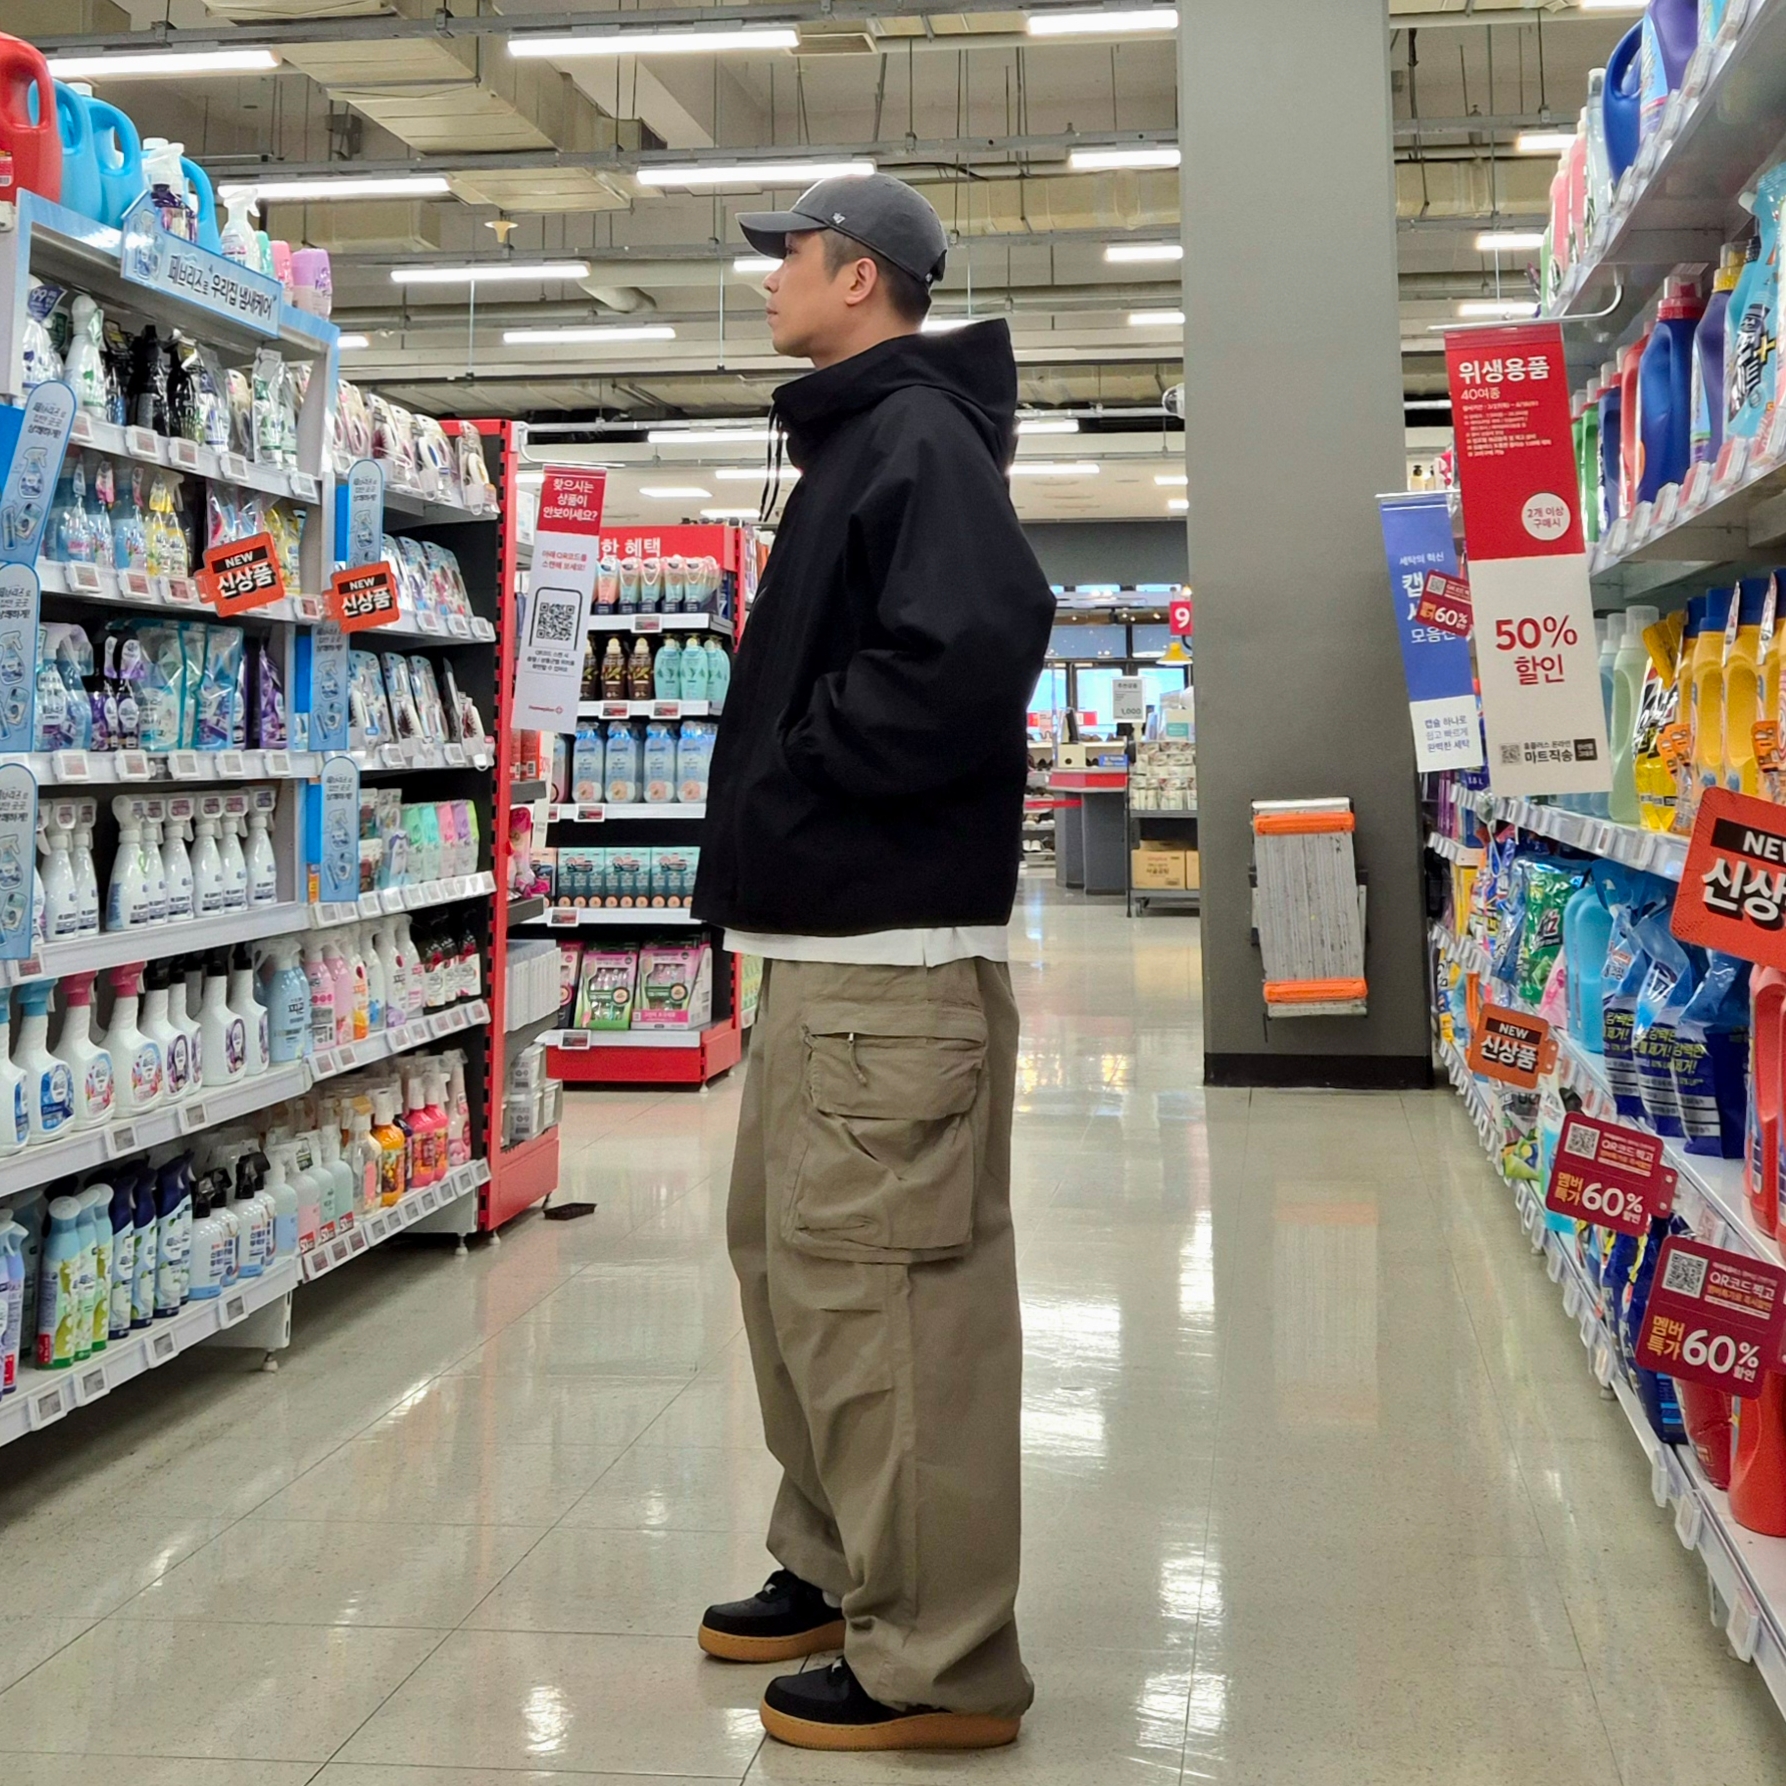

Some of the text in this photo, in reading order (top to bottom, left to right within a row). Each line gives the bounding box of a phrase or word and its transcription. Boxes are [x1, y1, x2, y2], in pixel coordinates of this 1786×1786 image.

[1458, 355, 1551, 385] 위생용품
[1460, 386, 1501, 400] 40여종
[553, 478, 594, 493] 찾으시는
[557, 492, 588, 507] 상품이
[543, 505, 598, 521] 안보이세요?
[1527, 506, 1564, 518] 2개 이상
[1533, 517, 1561, 529] 구매시
[624, 537, 661, 558] 혜택
[225, 551, 253, 568] NEW
[217, 561, 274, 599] 신상품
[349, 577, 375, 590] NEW
[341, 587, 391, 617] 신상품
[1175, 606, 1190, 630] 9
[1434, 606, 1468, 626] 60%
[1495, 614, 1578, 650] 50%
[1514, 653, 1565, 686] 할인
[1443, 715, 1467, 726] 하나로
[1524, 748, 1573, 764] 마트직송
[1499, 1022, 1529, 1040] NEW
[1480, 1034, 1538, 1071] 신상품
[1601, 1139, 1635, 1157] QR코드
[1557, 1171, 1584, 1192] 멤버
[1554, 1185, 1580, 1207] 특가
[1581, 1182, 1644, 1217] 60%
[1709, 1271, 1752, 1294] QR코드
[1752, 1283, 1775, 1301] 찍고
[1651, 1315, 1685, 1342] 멤버
[1646, 1333, 1681, 1361] 특가
[1682, 1328, 1761, 1374] 60%
[1733, 1364, 1757, 1383] 할인
